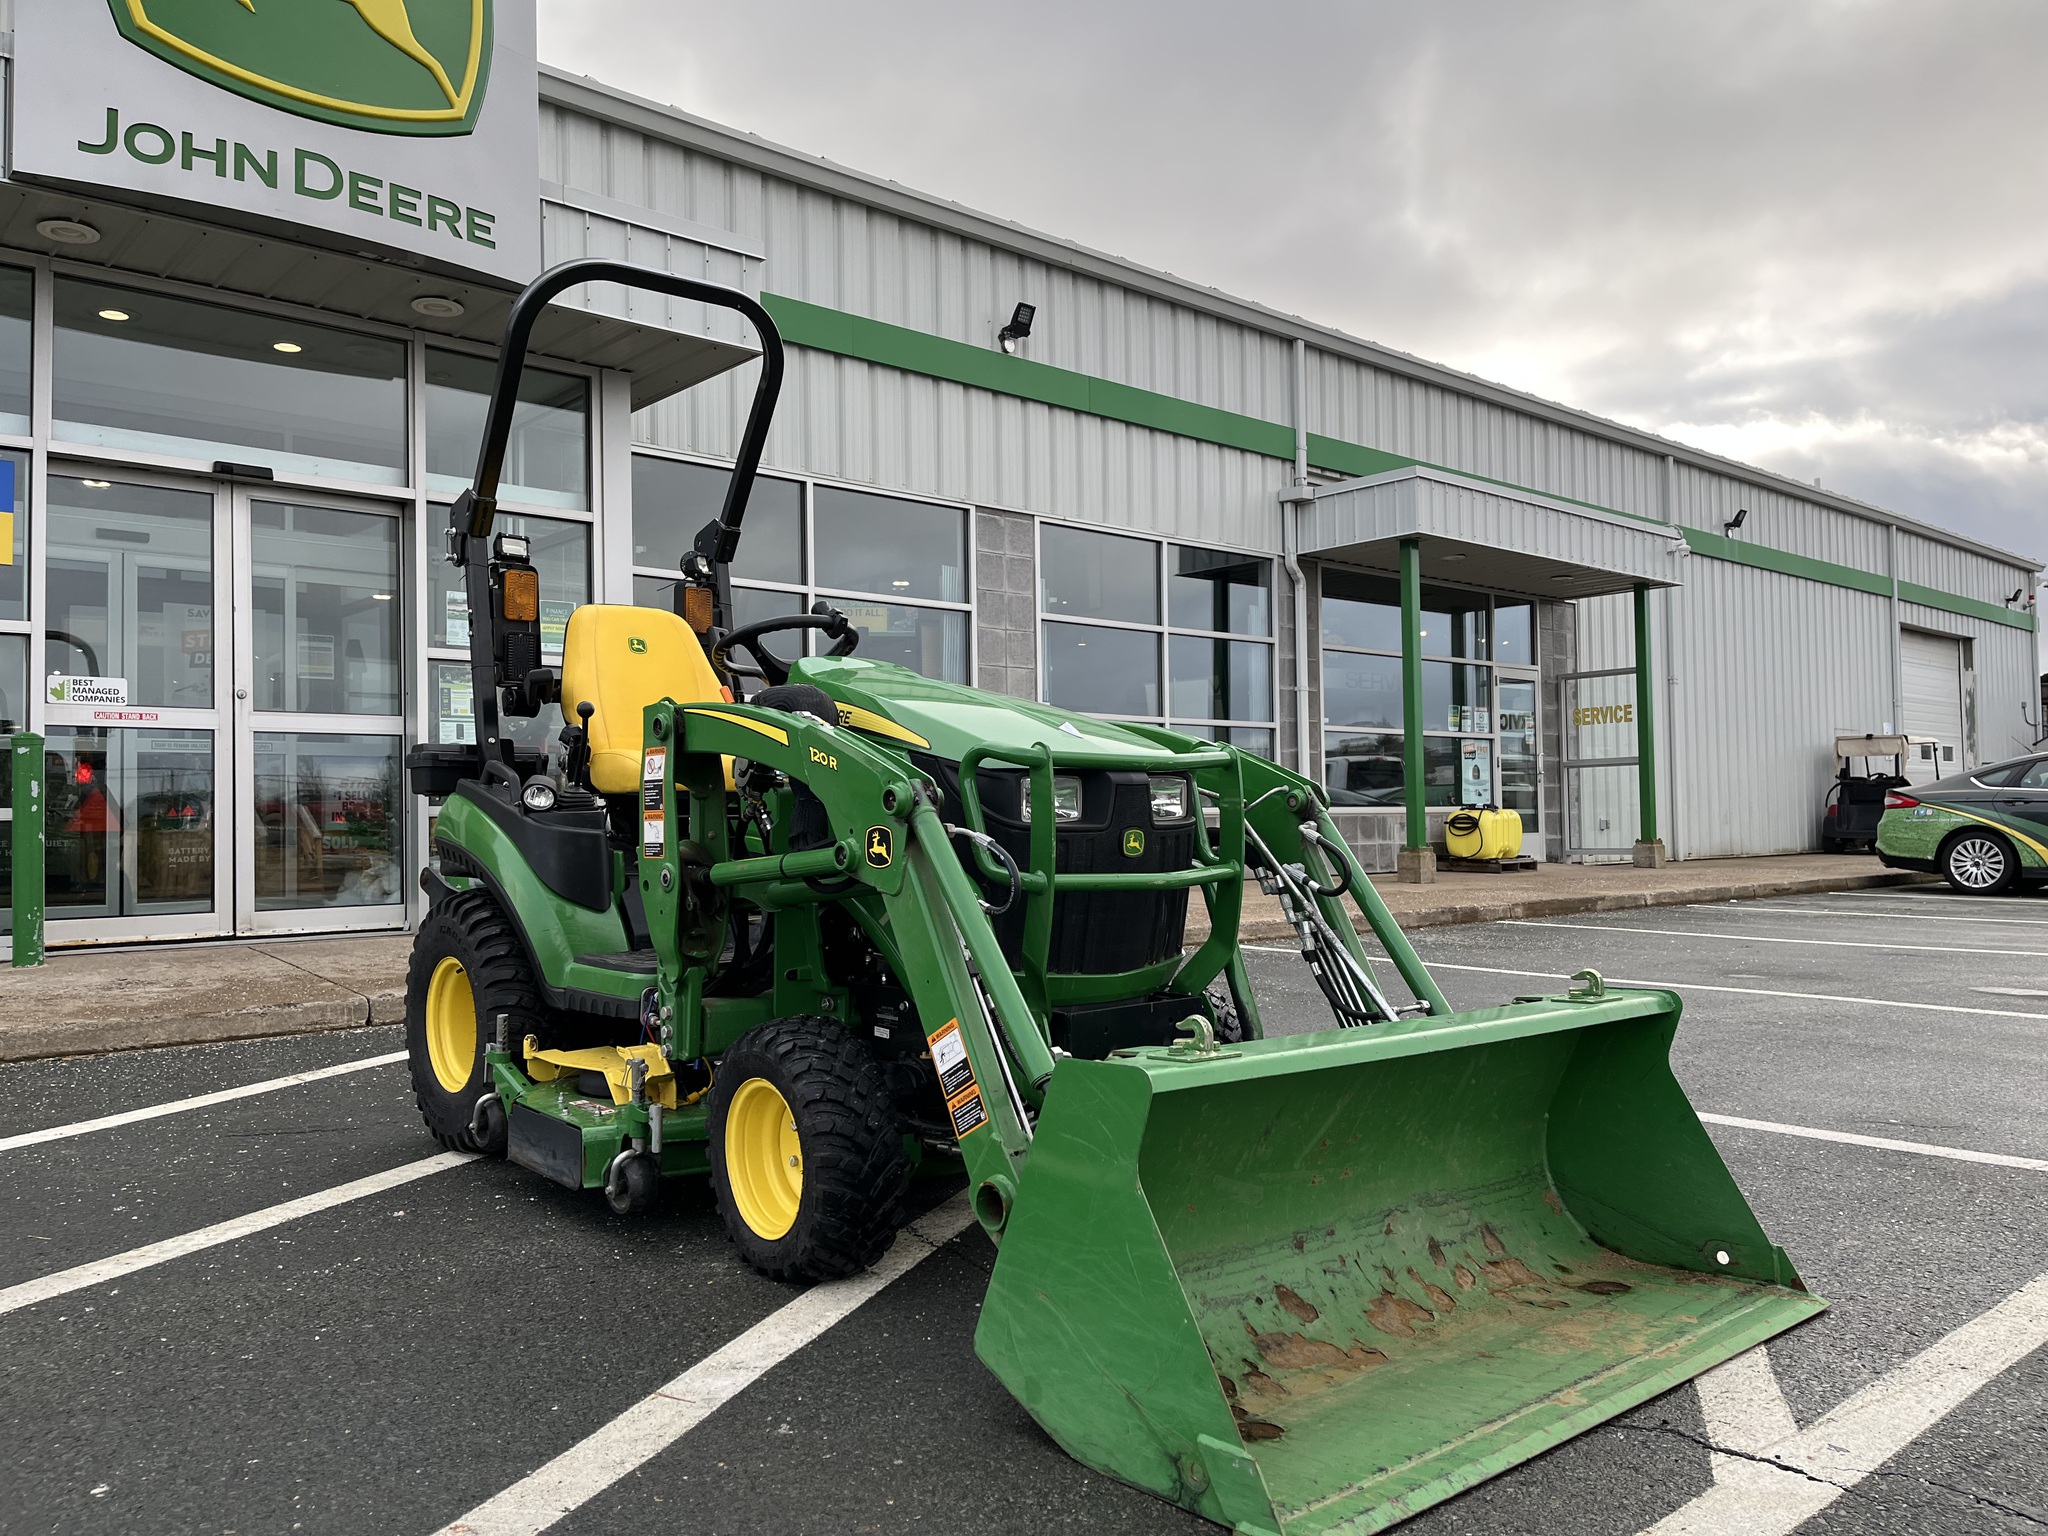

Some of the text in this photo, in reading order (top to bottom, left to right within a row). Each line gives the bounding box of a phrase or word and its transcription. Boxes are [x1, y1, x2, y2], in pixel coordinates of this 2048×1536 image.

[77, 107, 496, 250] JOHN DEERE
[186, 608, 210, 618] SAV
[545, 607, 569, 616] FINANCE
[855, 608, 864, 617] IT
[184, 634, 211, 648] ST
[195, 652, 212, 665] DE
[72, 679, 94, 687] BEST
[1345, 671, 1401, 691] SERV
[72, 687, 120, 696] MANAGED
[72, 695, 126, 704] COMPANIES
[95, 712, 120, 720] CAUTION
[837, 709, 853, 725] RE
[1573, 704, 1633, 726] SERVICE
[649, 747, 665, 755] WARNING
[46, 839, 69, 848] UIET
[168, 846, 210, 855] BATTERY
[168, 855, 196, 863] MADE
[935, 1022, 955, 1039] WARNING
[956, 1088, 977, 1105] WARNING
